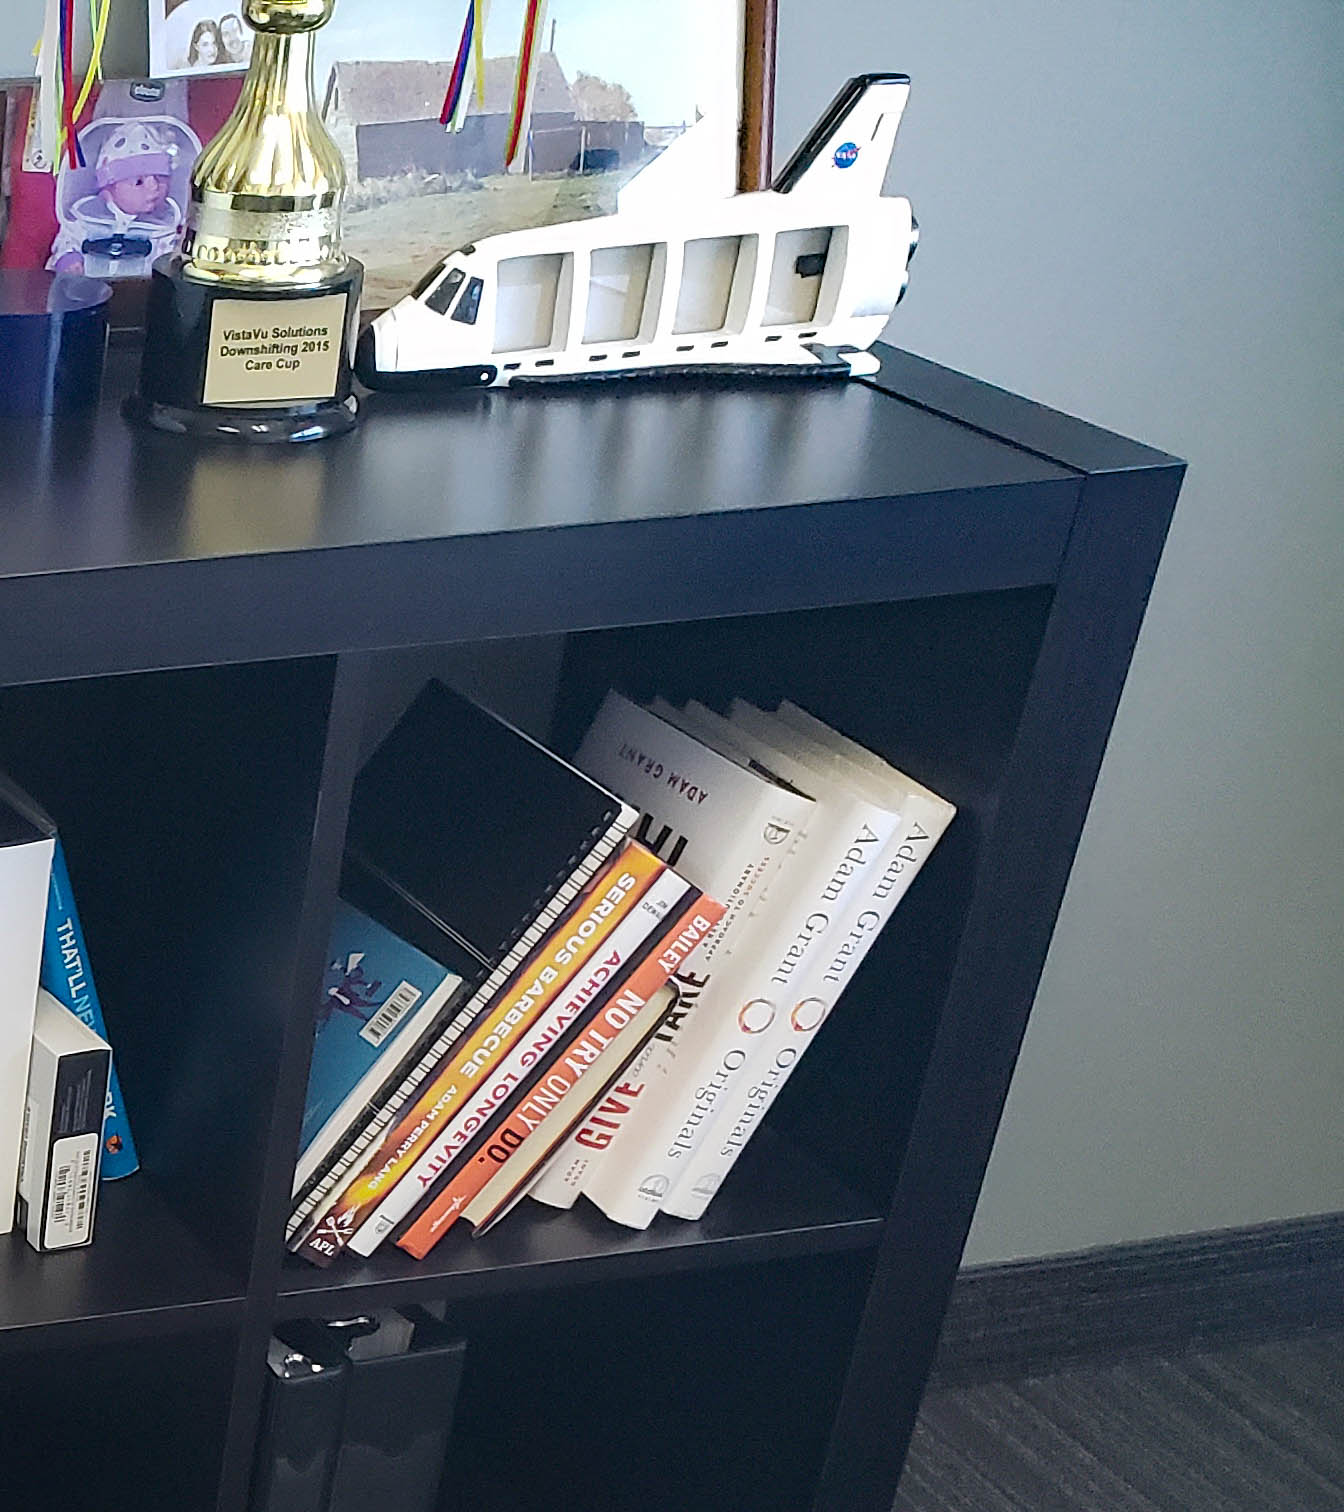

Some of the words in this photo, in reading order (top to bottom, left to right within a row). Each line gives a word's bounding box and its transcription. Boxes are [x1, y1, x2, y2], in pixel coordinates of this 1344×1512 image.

[220, 343, 299, 357] Downshifting
[301, 341, 330, 353] 2015
[223, 328, 269, 341] VistaVu
[272, 326, 328, 339] Solutions
[245, 360, 273, 371] Care
[275, 358, 300, 371] Cup
[618, 743, 664, 779] GRANT
[667, 772, 709, 805] ADAM
[821, 823, 881, 902] Adam
[872, 821, 931, 899] Adam
[554, 872, 637, 966] SERIOUS
[658, 914, 711, 974] BAILEY
[771, 912, 829, 985] Grant
[823, 910, 880, 983] Grant
[56, 917, 85, 998] THAT'LL
[460, 967, 559, 1078] BARBECUE
[518, 950, 622, 1068] ACHIEVING
[603, 988, 646, 1031] NO
[564, 1027, 615, 1079] TRY
[417, 1072, 519, 1189] LONGEVITY
[426, 1084, 458, 1121] ADAM
[515, 1074, 572, 1132] ONLY
[575, 1081, 645, 1151] GIVE
[668, 1049, 746, 1159] Originals
[721, 1048, 797, 1157] Originals
[395, 1120, 429, 1161] PERRY
[478, 1127, 525, 1165] DO.
[368, 1158, 399, 1190] LANG
[309, 1237, 336, 1257] APL
